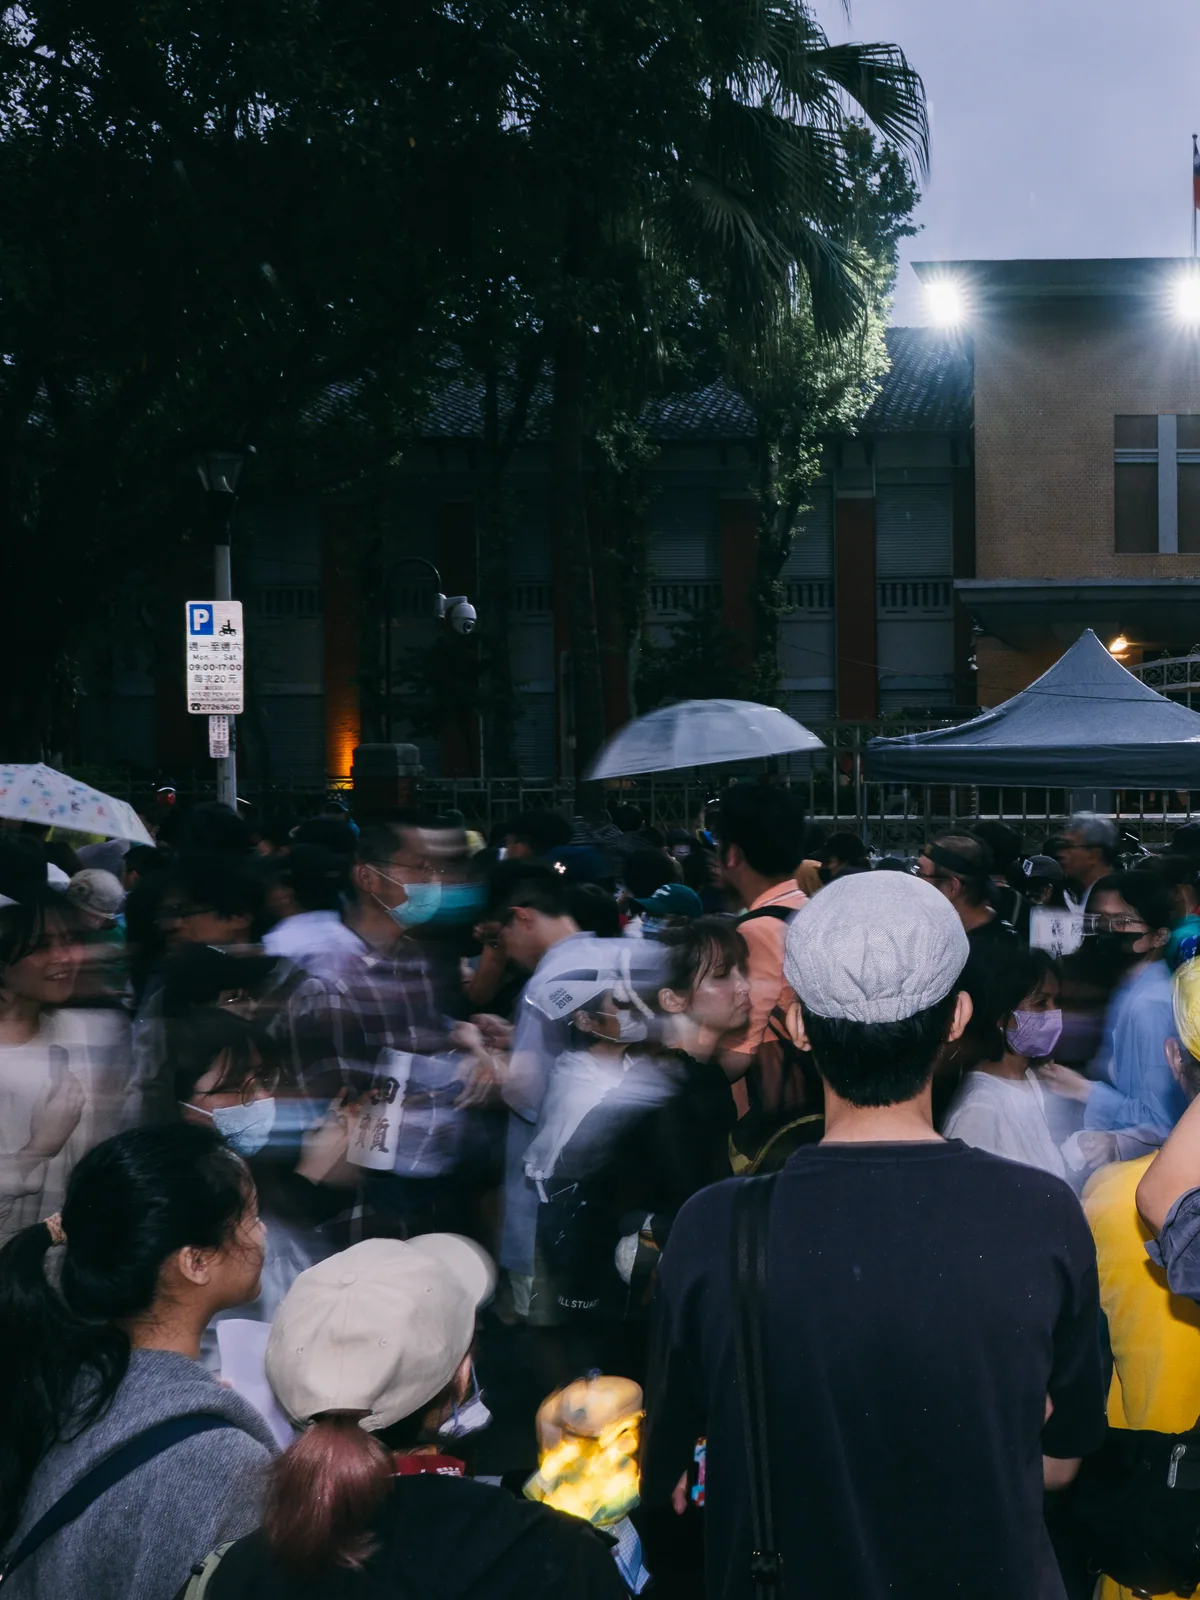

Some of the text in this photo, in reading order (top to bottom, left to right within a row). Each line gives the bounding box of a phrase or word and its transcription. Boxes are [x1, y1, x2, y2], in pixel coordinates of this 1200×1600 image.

[193, 608, 210, 631] P
[189, 663, 242, 671] 09:00-17:00
[554, 993, 574, 1010] 2018
